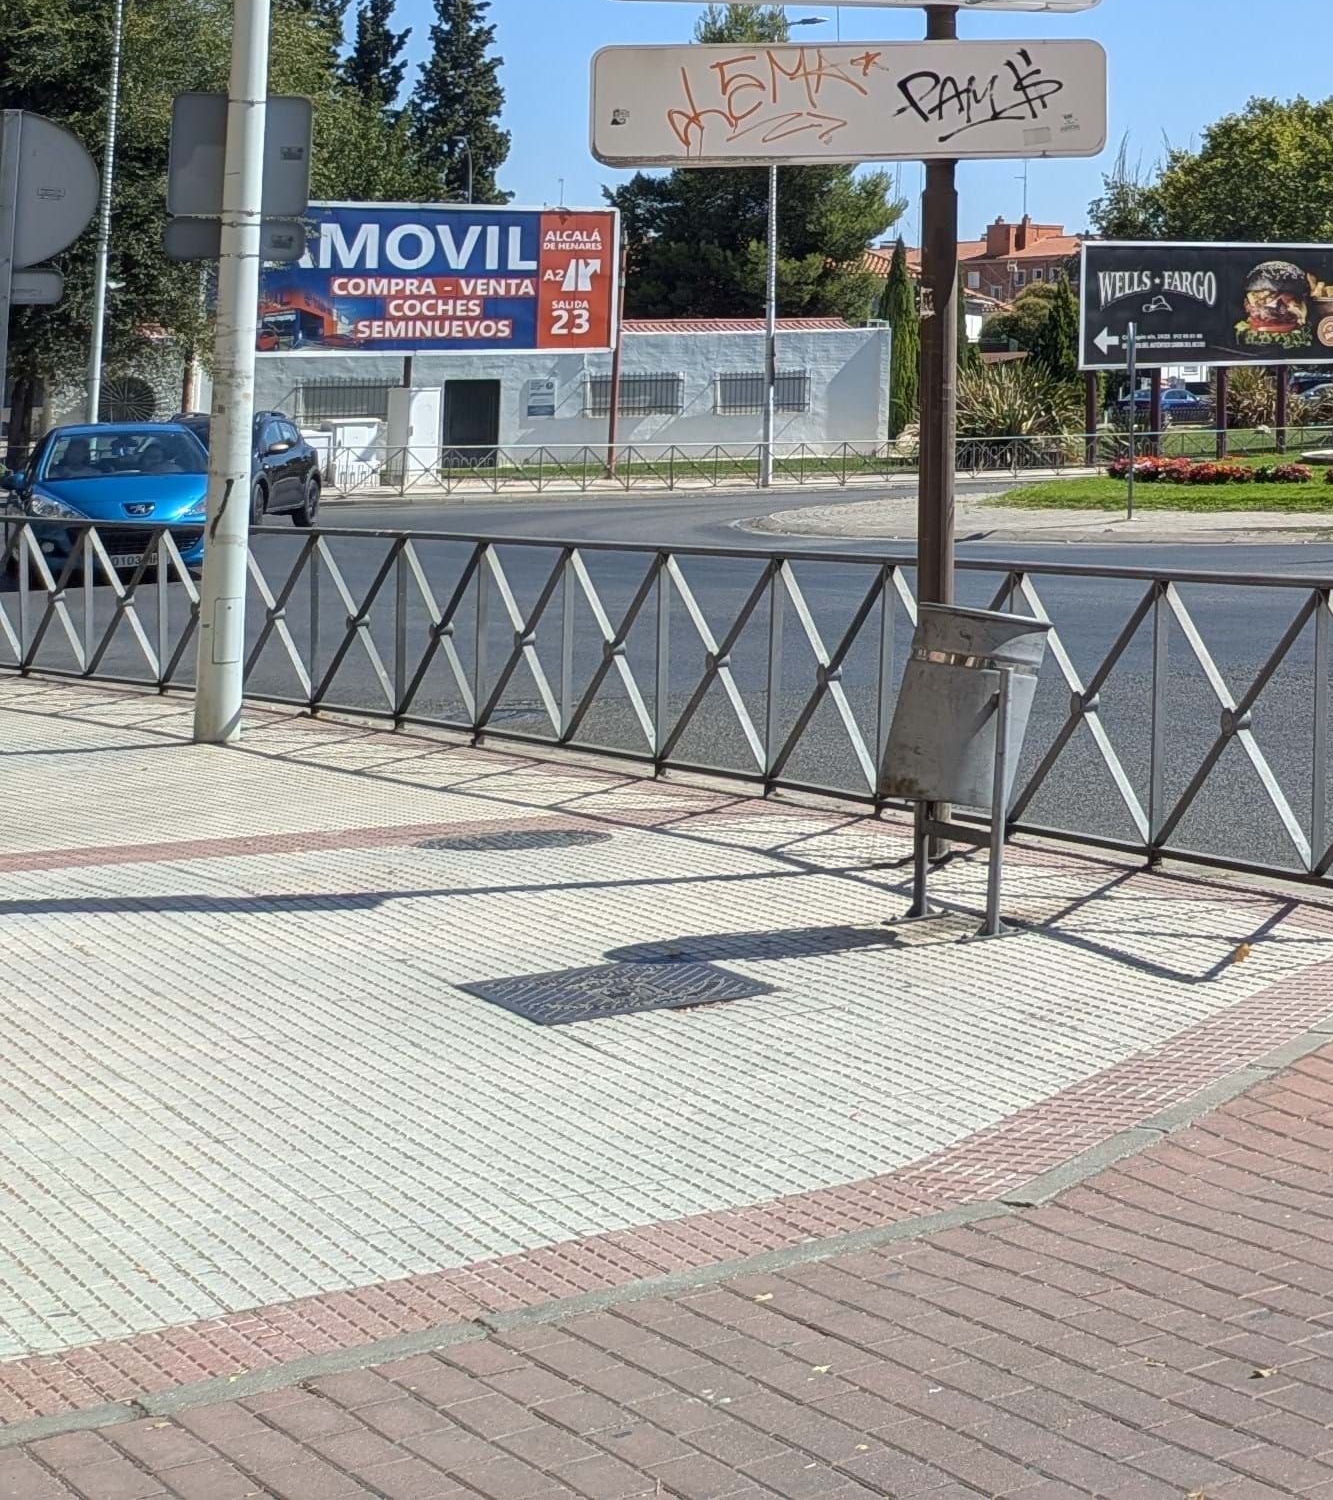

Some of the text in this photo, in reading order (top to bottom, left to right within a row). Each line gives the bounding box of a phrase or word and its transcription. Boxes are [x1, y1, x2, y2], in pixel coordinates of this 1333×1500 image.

[545, 228, 601, 241] ALCALÁ
[298, 223, 537, 270] MOVIL
[543, 242, 555, 250] DE
[543, 269, 564, 281] A2
[333, 278, 436, 296] COMPRA
[459, 279, 535, 296] VENTA
[1098, 271, 1216, 309] WELLS FARGO
[388, 300, 481, 317] COCHES
[552, 300, 589, 309] SALIDA
[356, 320, 510, 338] SEMINUEVOS
[551, 310, 590, 334] 23
